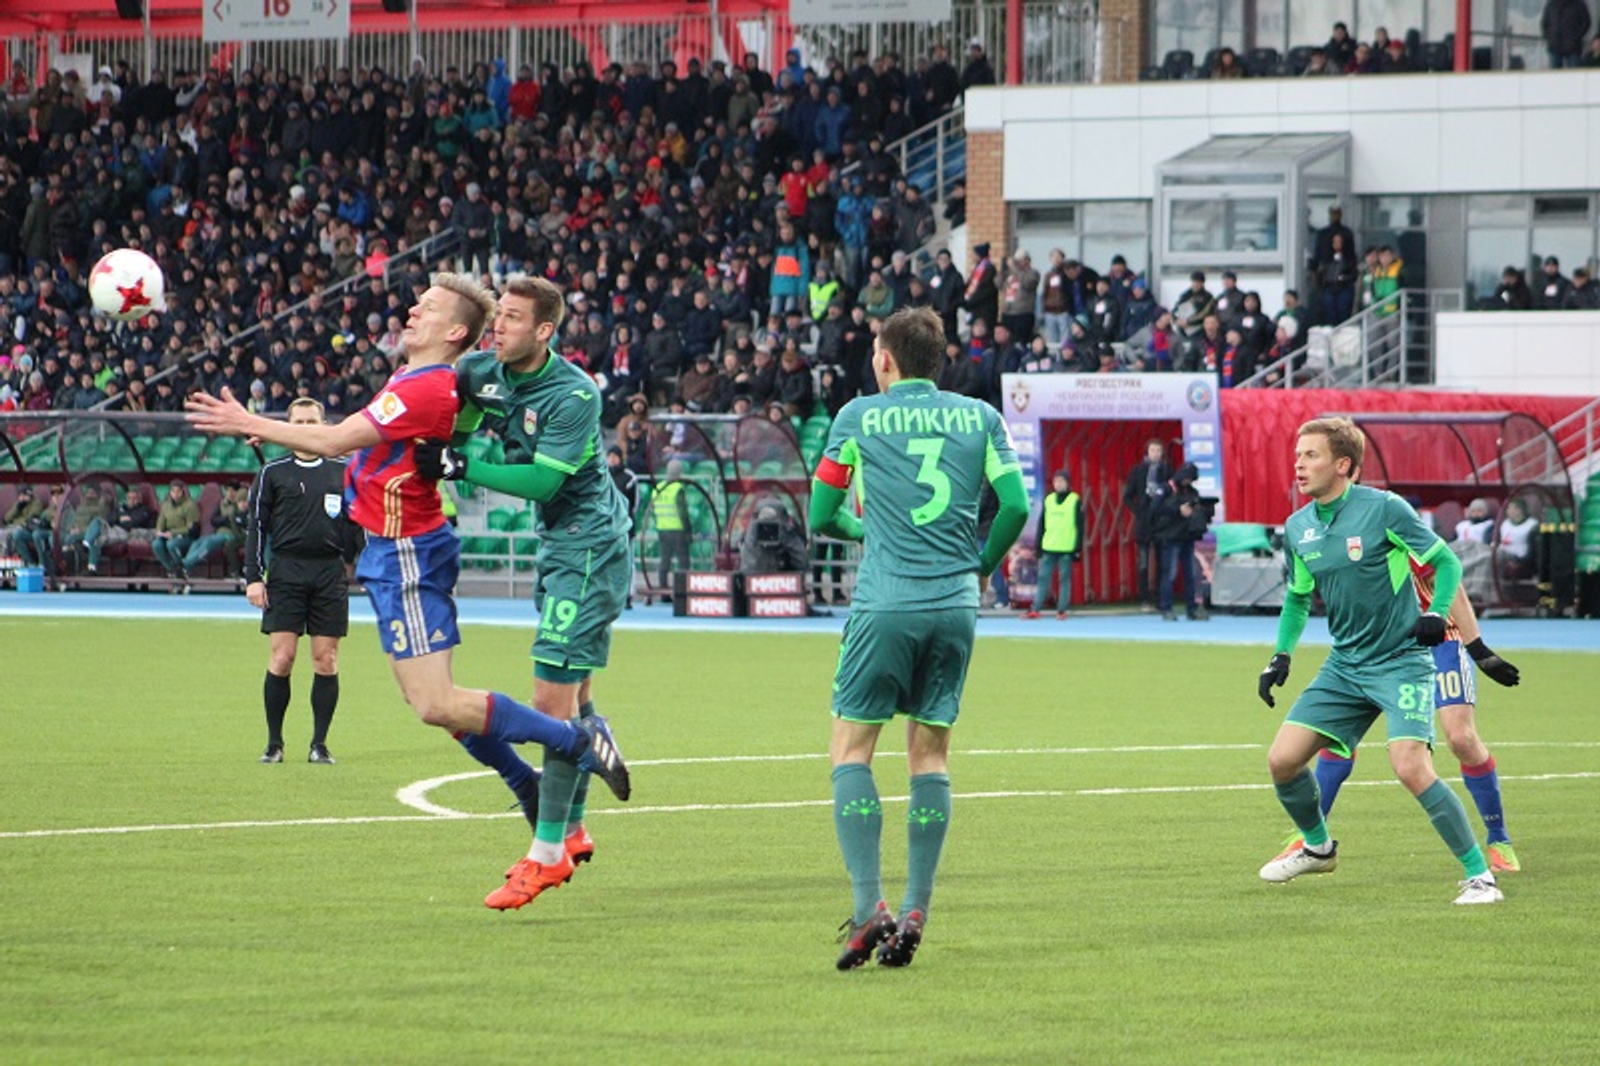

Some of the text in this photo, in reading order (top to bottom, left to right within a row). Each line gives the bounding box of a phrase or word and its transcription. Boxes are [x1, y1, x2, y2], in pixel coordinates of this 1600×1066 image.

[263, 0, 290, 17] 16
[862, 406, 983, 437] АЛИКИН
[906, 437, 952, 526] 3
[540, 596, 578, 633] 19
[390, 620, 407, 652] 3
[1398, 684, 1429, 712] 87
[1436, 670, 1461, 701] 10
